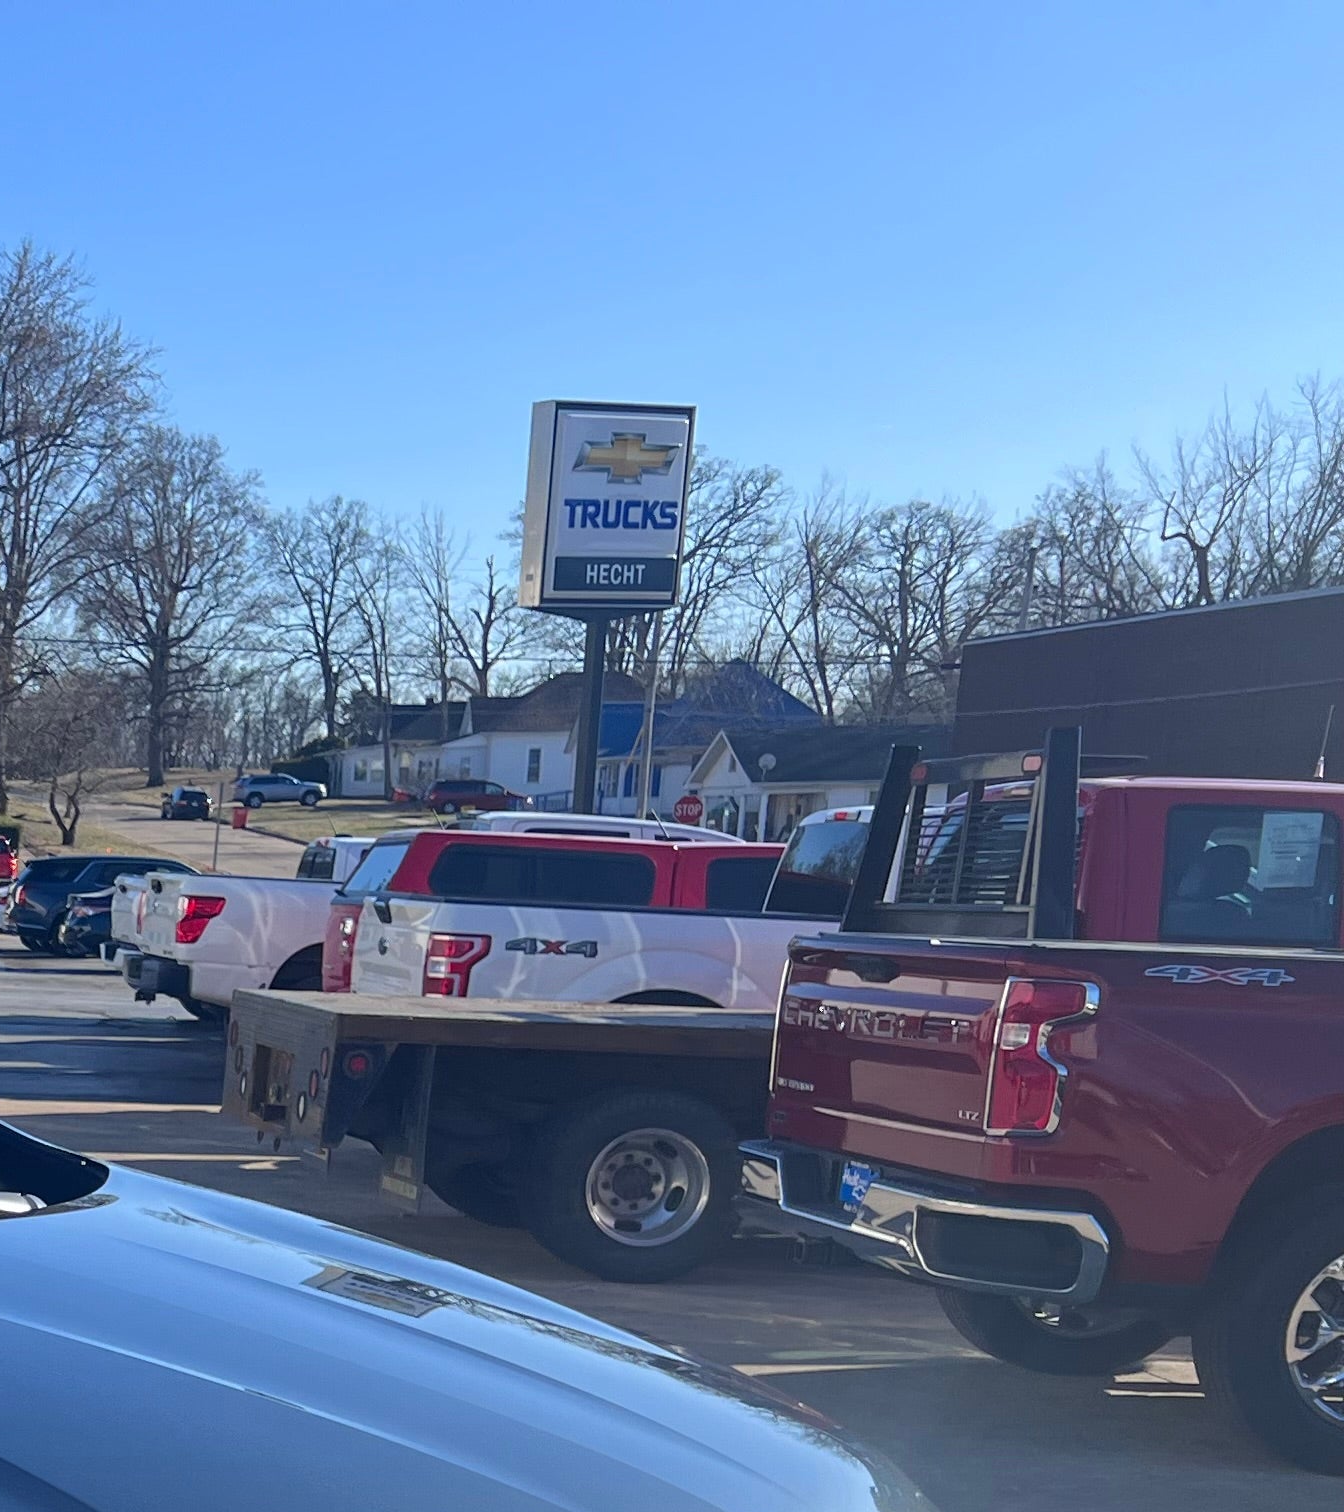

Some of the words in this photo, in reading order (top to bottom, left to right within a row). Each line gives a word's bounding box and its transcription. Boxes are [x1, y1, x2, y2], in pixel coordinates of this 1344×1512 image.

[564, 498, 678, 530] TRUCKS
[585, 563, 646, 586] HECHT
[675, 803, 702, 817] STOP
